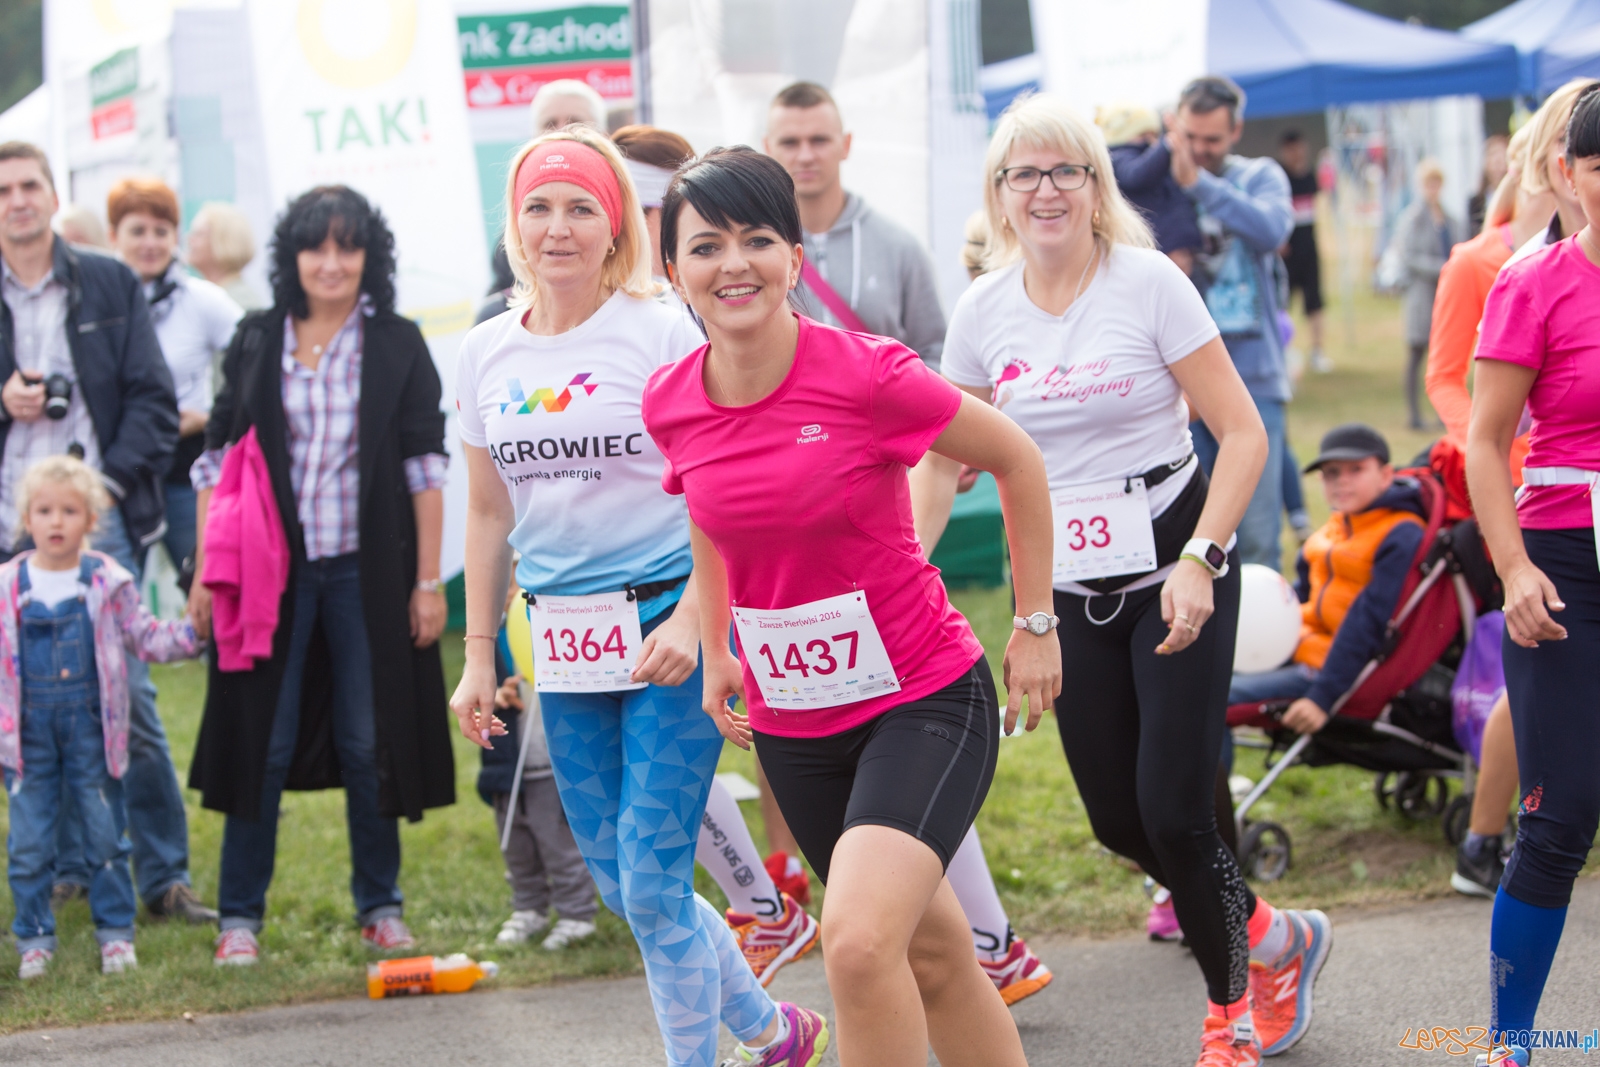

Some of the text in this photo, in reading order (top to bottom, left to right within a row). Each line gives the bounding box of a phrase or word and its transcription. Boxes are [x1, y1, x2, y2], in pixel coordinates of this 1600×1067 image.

[302, 95, 432, 154] TAK!
[1042, 376, 1136, 403] Biegamy
[796, 433, 829, 445] Kalenji
[553, 467, 602, 482] energię
[1067, 515, 1112, 552] 33
[594, 603, 614, 613] 2016
[758, 620, 784, 629] Zawsze
[784, 615, 818, 628] Pier(w)si
[819, 610, 842, 622] 2016
[543, 624, 628, 663] 1364
[758, 629, 859, 679] 1437
[719, 843, 743, 868] SKIN
